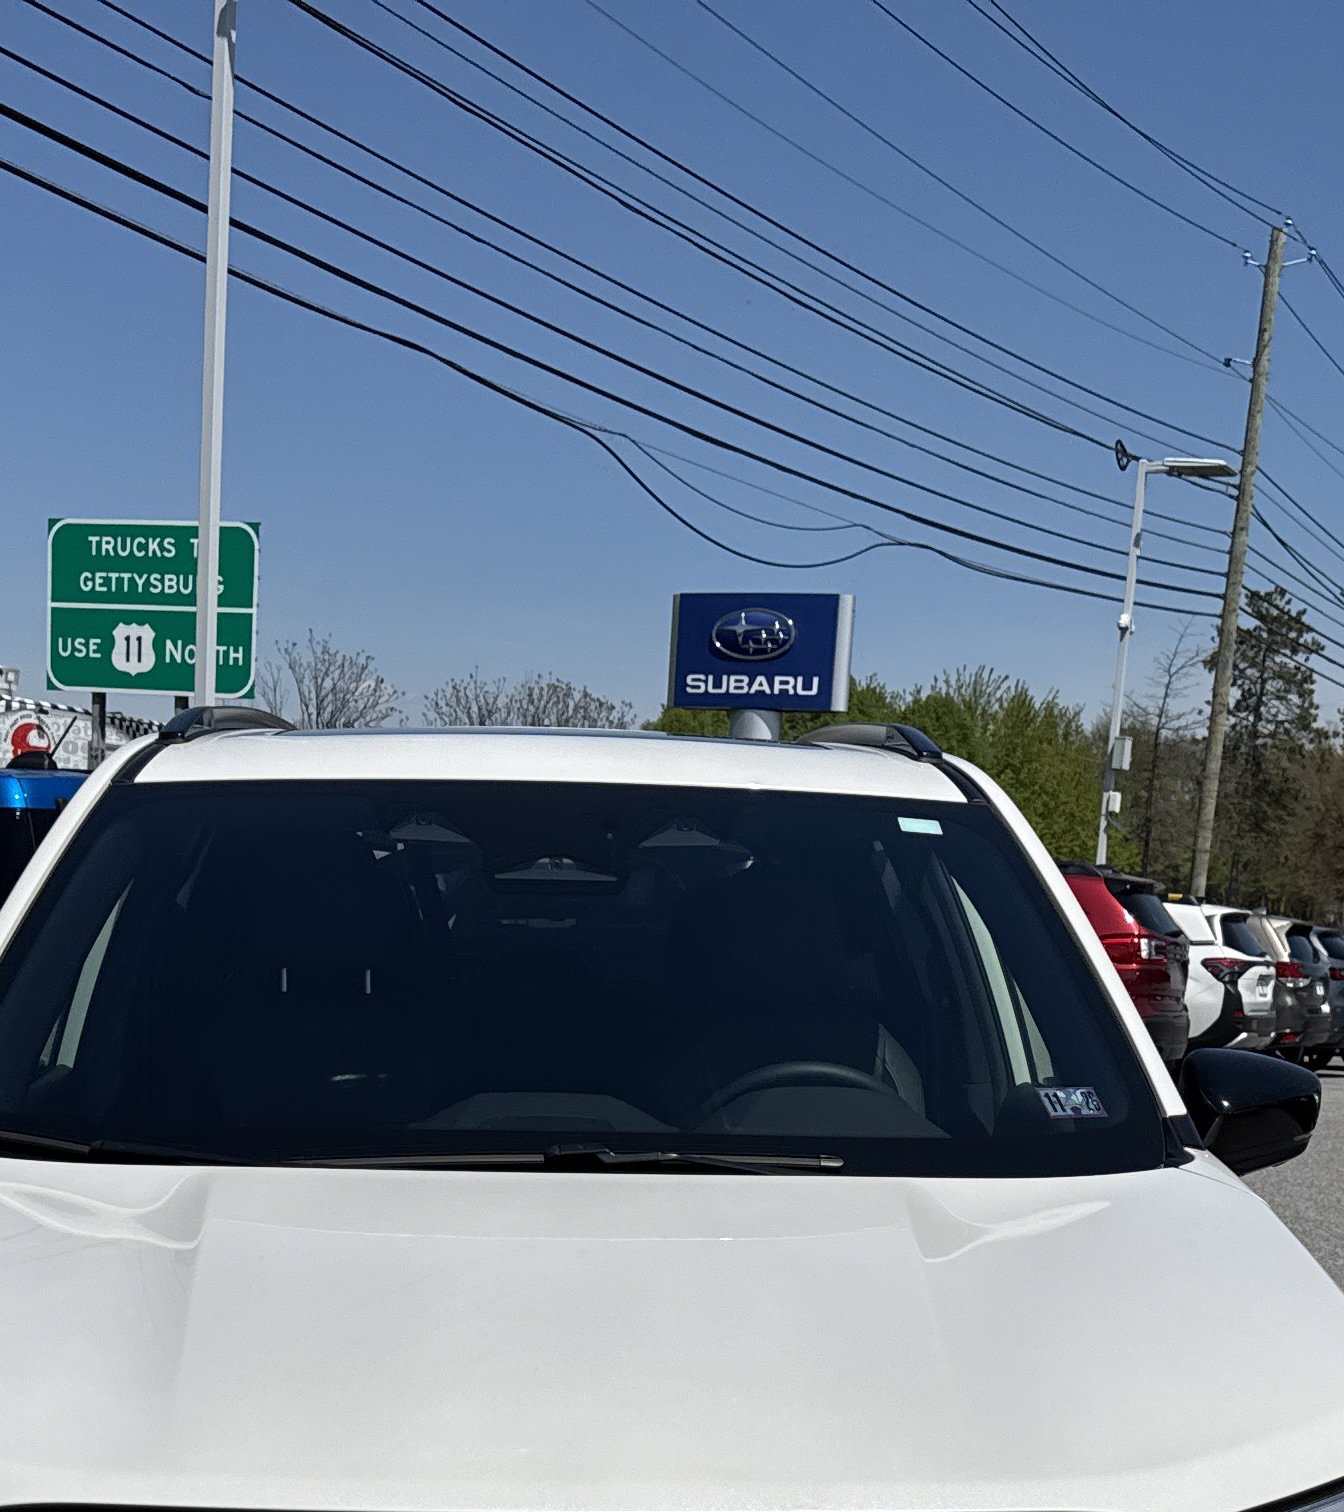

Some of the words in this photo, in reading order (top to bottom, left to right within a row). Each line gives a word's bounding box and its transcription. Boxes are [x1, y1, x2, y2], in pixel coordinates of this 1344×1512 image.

[88, 536, 176, 558] TRUCKS
[79, 571, 224, 594] GETTYSBUG
[58, 637, 102, 658] USE
[124, 635, 143, 663] 11
[165, 639, 244, 666] NOTH
[685, 673, 819, 696] SUBARU
[1044, 1092, 1067, 1113] 11
